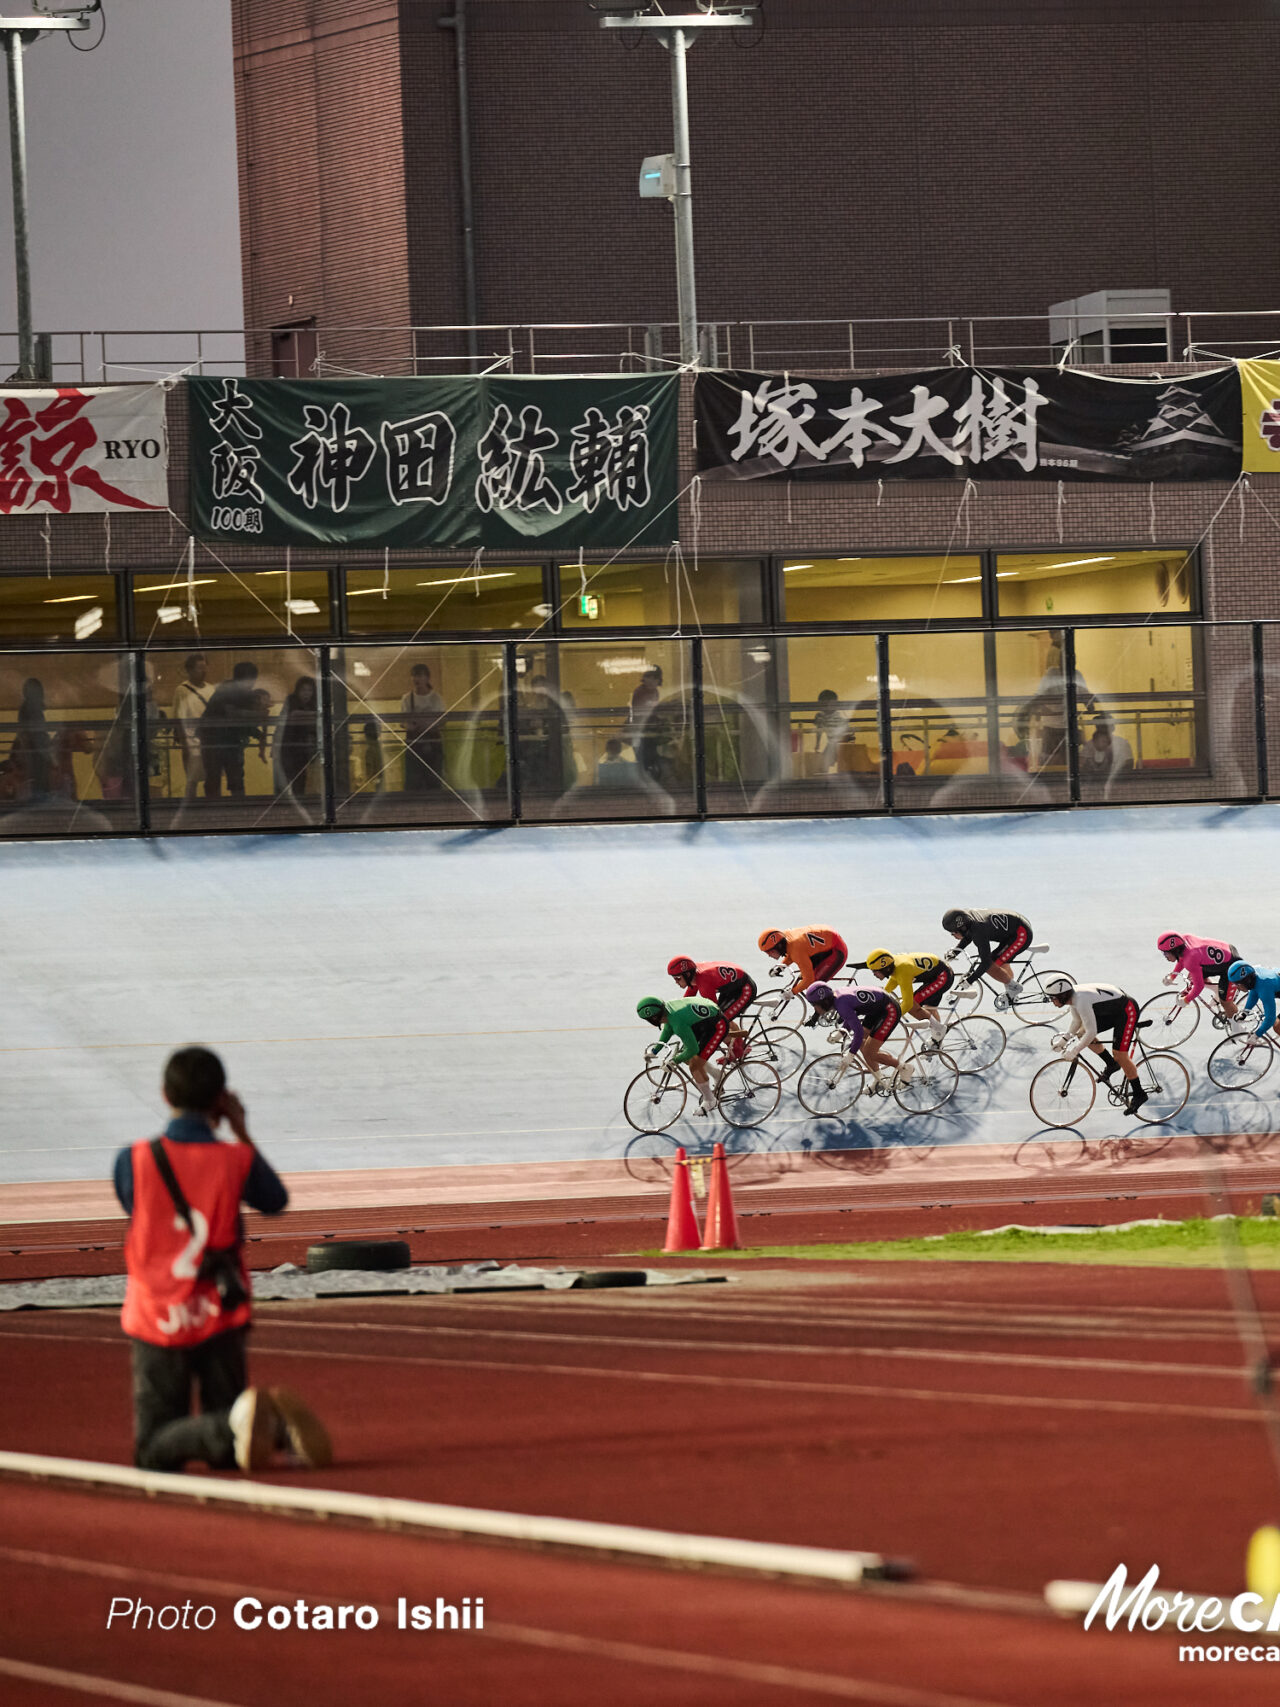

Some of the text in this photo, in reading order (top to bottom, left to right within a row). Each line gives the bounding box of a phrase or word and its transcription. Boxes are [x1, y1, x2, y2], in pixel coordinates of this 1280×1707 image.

[727, 375, 1049, 472] 塚本大樹
[103, 439, 160, 459] RYO
[209, 378, 265, 504] 大阪
[211, 506, 263, 533] 100期
[991, 914, 1008, 931] 2
[807, 932, 826, 948] 7
[1207, 946, 1224, 964] 8
[914, 957, 933, 972] 5
[718, 966, 737, 982] 3
[856, 990, 876, 1003] 9
[691, 1004, 711, 1019] 6
[171, 1208, 209, 1279] 2
